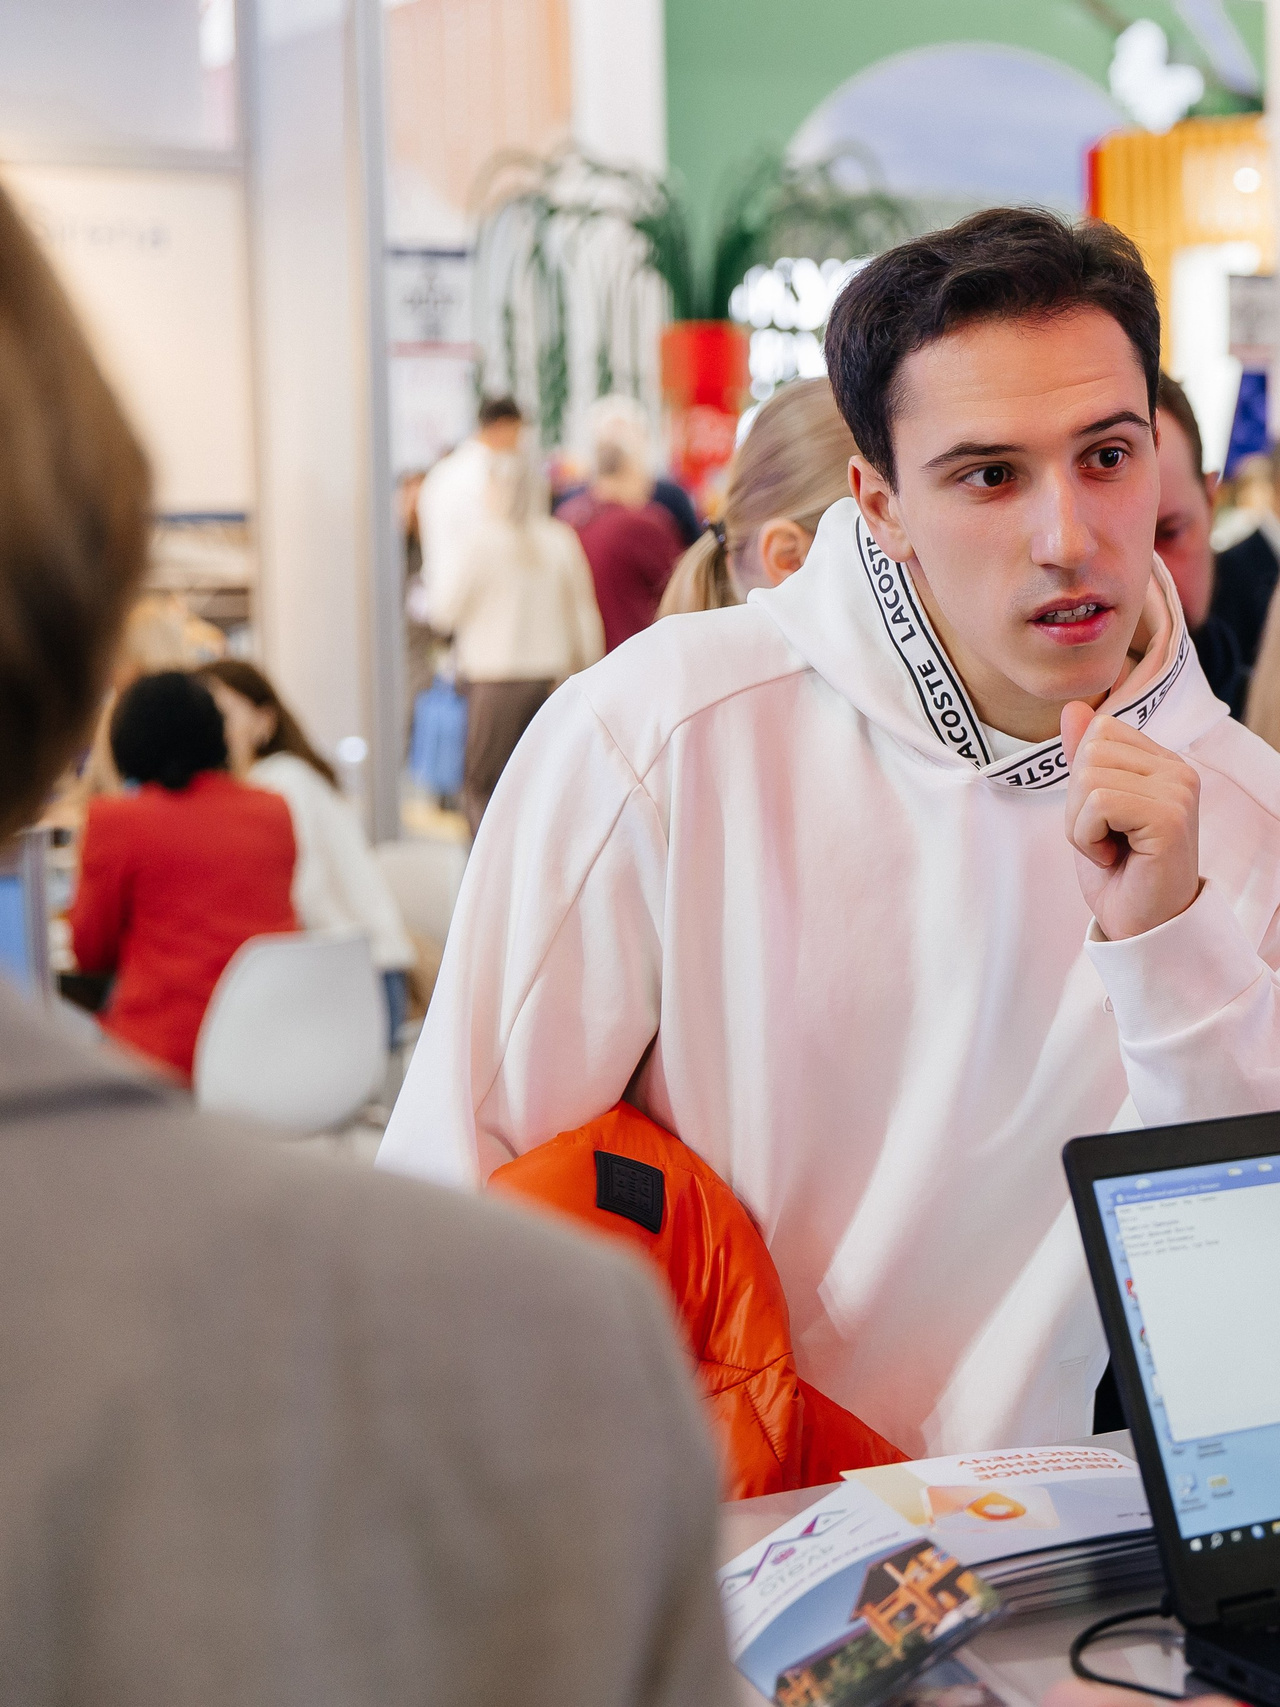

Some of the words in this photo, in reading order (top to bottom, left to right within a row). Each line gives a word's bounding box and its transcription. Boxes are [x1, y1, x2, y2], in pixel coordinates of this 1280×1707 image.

[958, 1451, 1109, 1467] НАВСТРЕЧУ
[970, 1457, 1119, 1473] ДВИЖЕНИЕ
[974, 1464, 1133, 1481] УВЕРЕННОЕ
